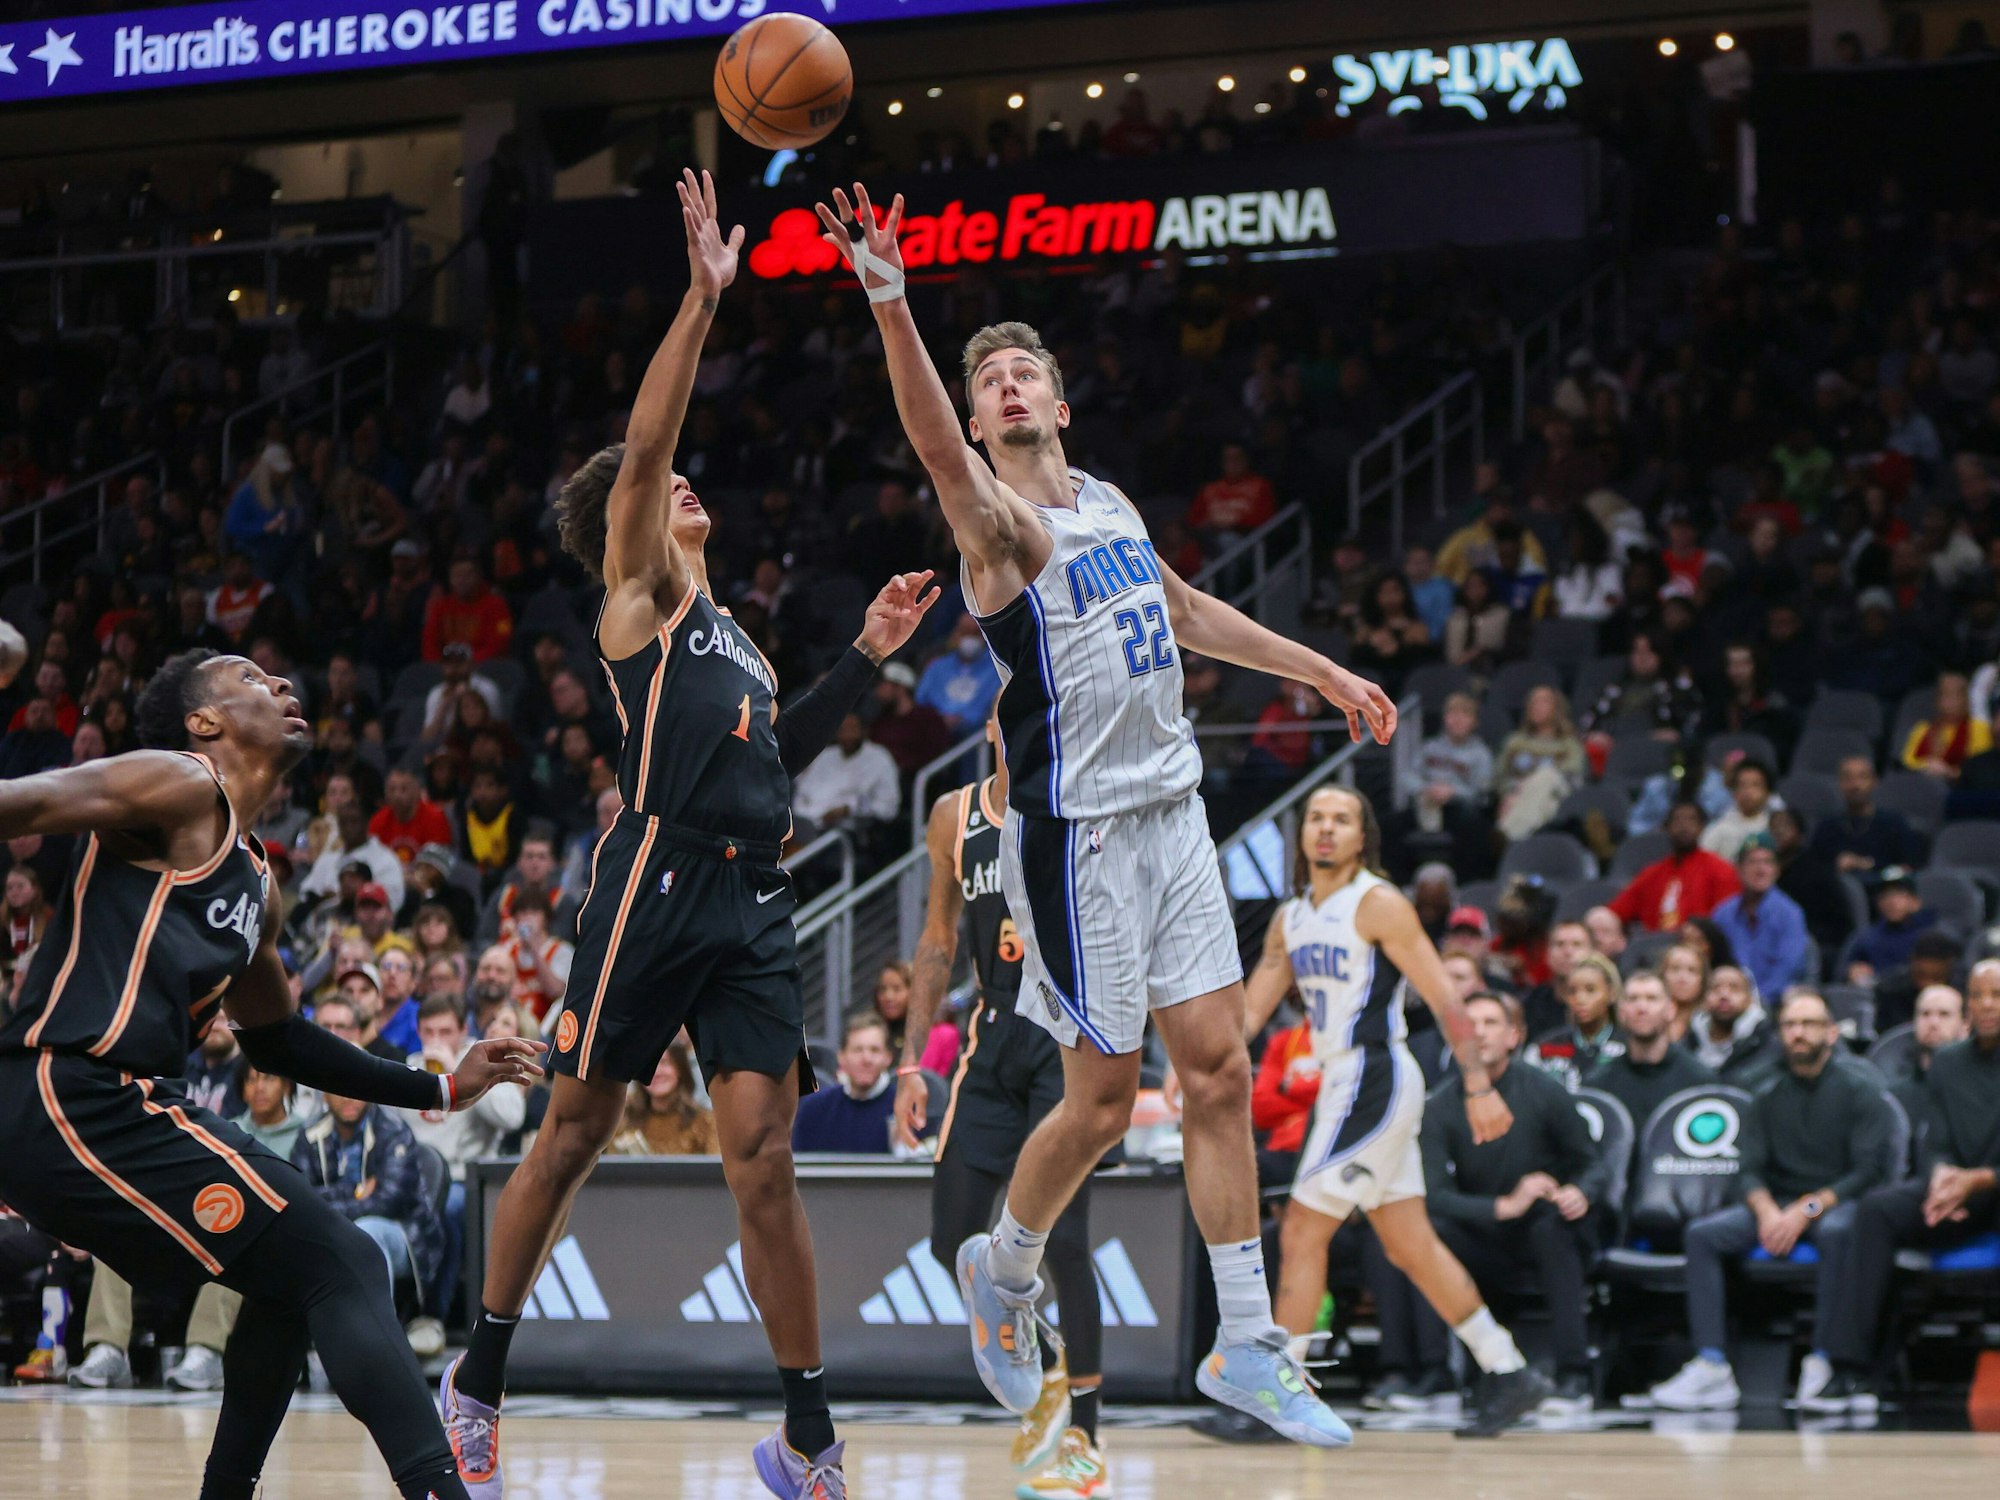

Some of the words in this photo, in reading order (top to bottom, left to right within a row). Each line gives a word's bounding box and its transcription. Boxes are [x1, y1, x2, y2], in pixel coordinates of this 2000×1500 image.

[268, 0, 518, 62] CHEROKEE
[841, 200, 998, 271] ate
[1001, 193, 1155, 260] Farm
[1154, 188, 1337, 250] ARENA
[688, 622, 775, 697] Atlanta
[1114, 601, 1174, 678] 22
[731, 693, 750, 741] 1
